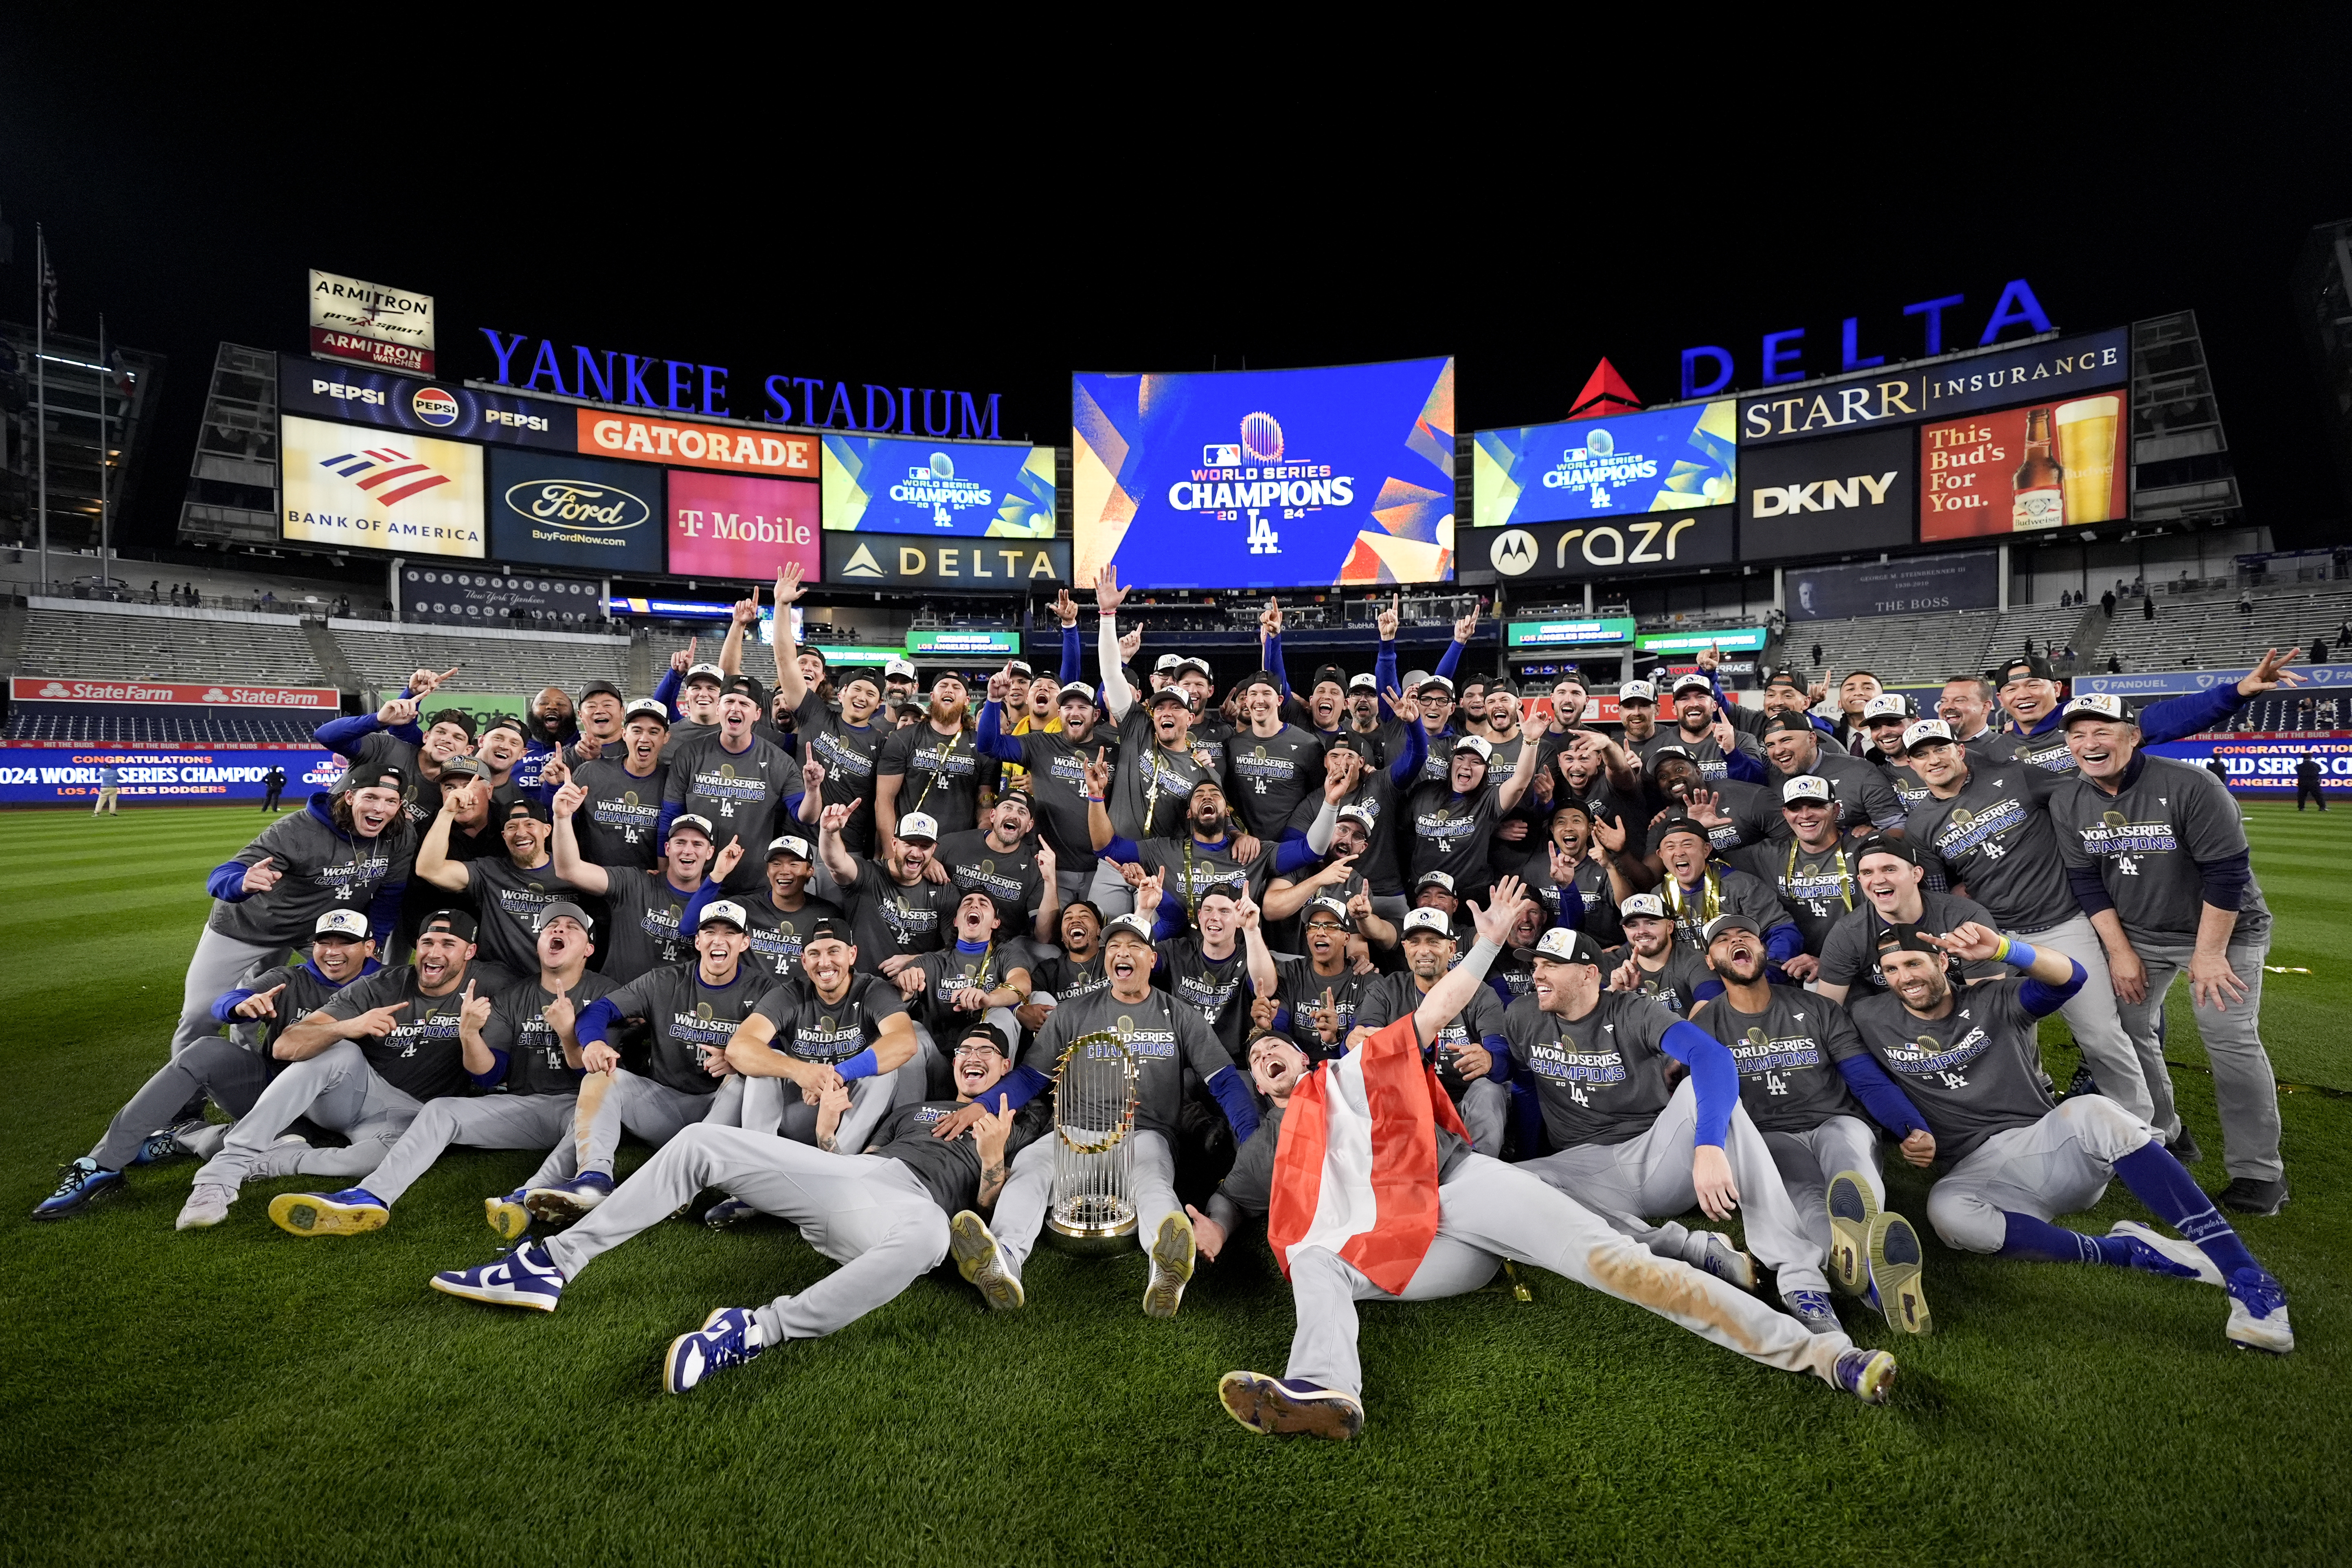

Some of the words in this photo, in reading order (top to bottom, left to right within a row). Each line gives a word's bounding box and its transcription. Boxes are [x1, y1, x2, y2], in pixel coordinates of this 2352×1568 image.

[315, 281, 427, 315] ARMITRON
[322, 333, 422, 362] ARMITRON
[1681, 279, 2052, 399] DELTA
[373, 353, 421, 369] WATCHES
[312, 379, 384, 406] PEPSI
[479, 327, 729, 418] YANKEE
[764, 375, 1002, 440] STADIUM
[1746, 381, 1916, 438] STARR
[1933, 347, 2117, 398] INSURANCE
[415, 399, 456, 415] PEPSI
[486, 409, 548, 432] PEPSI
[593, 419, 808, 468] GATORADE
[1929, 424, 1991, 449] This
[1557, 460, 1597, 470] WORLD
[1600, 454, 1643, 466] SERIES
[1930, 443, 2005, 470] Bud's
[1191, 468, 1257, 481] WORLD
[1263, 465, 1331, 479] SERIES
[1543, 460, 1657, 487] CHAMPIONS
[1930, 472, 1976, 491] For
[902, 479, 940, 488] WORLD
[942, 481, 979, 489] SERIES
[1169, 476, 1354, 510] CHAMPIONS
[532, 483, 625, 525] Ford
[890, 485, 992, 505] CHAMPIONS
[1590, 482, 1610, 509] LA
[1753, 471, 1898, 518] DKNY
[1929, 493, 1988, 512] You.
[933, 502, 951, 527] LA
[2015, 516, 2060, 526] Budweiser
[288, 510, 349, 528] BANK
[355, 518, 382, 533] OF
[387, 522, 479, 542] AMERICA
[711, 511, 810, 546] Mobile
[1217, 510, 1237, 520] 20
[1247, 509, 1278, 554] LA
[1284, 509, 1305, 519] 24
[532, 529, 626, 547] BuyFordNow.com
[1557, 518, 1695, 569] razr
[900, 546, 1057, 579] DELTA
[463, 589, 485, 599] New
[485, 591, 507, 603] York
[509, 593, 545, 605] Yankees
[1875, 600, 1904, 612] THE
[1911, 596, 1949, 609] BOSS
[1578, 631, 1623, 639] DODGERS
[1663, 639, 1688, 648] WORLD
[1668, 667, 1700, 678] TOYOT
[1716, 664, 1752, 674] ERRACE
[2111, 680, 2167, 689] FANDUEL
[813, 737, 871, 776] CHAMPIONS
[819, 731, 844, 754] WORLD
[843, 750, 873, 768] SERIES
[2213, 744, 2352, 754] CONGRATULATIO
[72, 755, 213, 764] CONGRATULATIONS
[948, 754, 975, 765] SERIES
[1236, 756, 1264, 765] WORLD
[1264, 759, 1294, 769] SERIES
[0, 767, 38, 784] 024
[39, 768, 104, 784] WORL
[117, 767, 178, 783] SERIES
[828, 762, 840, 782] LA
[937, 772, 949, 789] LA
[1235, 764, 1294, 779] CHAMPIONS
[57, 787, 88, 795] LOS
[89, 786, 157, 794] AELES
[159, 786, 226, 794] DODGERS
[693, 783, 766, 800] CHAMPIONS
[695, 774, 731, 786] WORLD
[732, 779, 766, 790] SERIES
[1255, 776, 1266, 794] LA
[597, 801, 635, 814] WORLD
[720, 798, 734, 818] LA
[1415, 823, 1475, 837] CHAMPIONS
[1935, 821, 1976, 848] WORLD
[1975, 798, 2020, 825] SERIES
[2123, 825, 2172, 837] SERIES
[624, 825, 638, 844] LA
[1942, 808, 2027, 859] CHAMPIONS
[1437, 837, 1452, 852] LA
[1979, 840, 2005, 860] LA
[2119, 851, 2140, 875] LA
[956, 865, 990, 881] WORLD
[990, 876, 1023, 890] SERIES
[501, 889, 544, 902] WORLD
[908, 910, 937, 920] SERIES
[1808, 899, 1827, 917] LA
[1182, 976, 1213, 994] WORLD
[674, 1013, 709, 1030] WORLD
[791, 1034, 866, 1056] CHAMPIONS
[1133, 1031, 1174, 1043] SERIES
[1769, 1038, 1815, 1053] SERIES
[1531, 1045, 1578, 1065] WORLD
[1579, 1053, 1622, 1067] SERIES
[1889, 1035, 1992, 1074] CHAMPIONS
[1530, 1058, 1626, 1083] CHAMPIONS
[1936, 1070, 1968, 1090] LA
[1766, 1070, 1787, 1095] LA
[1569, 1081, 1590, 1108] LA
